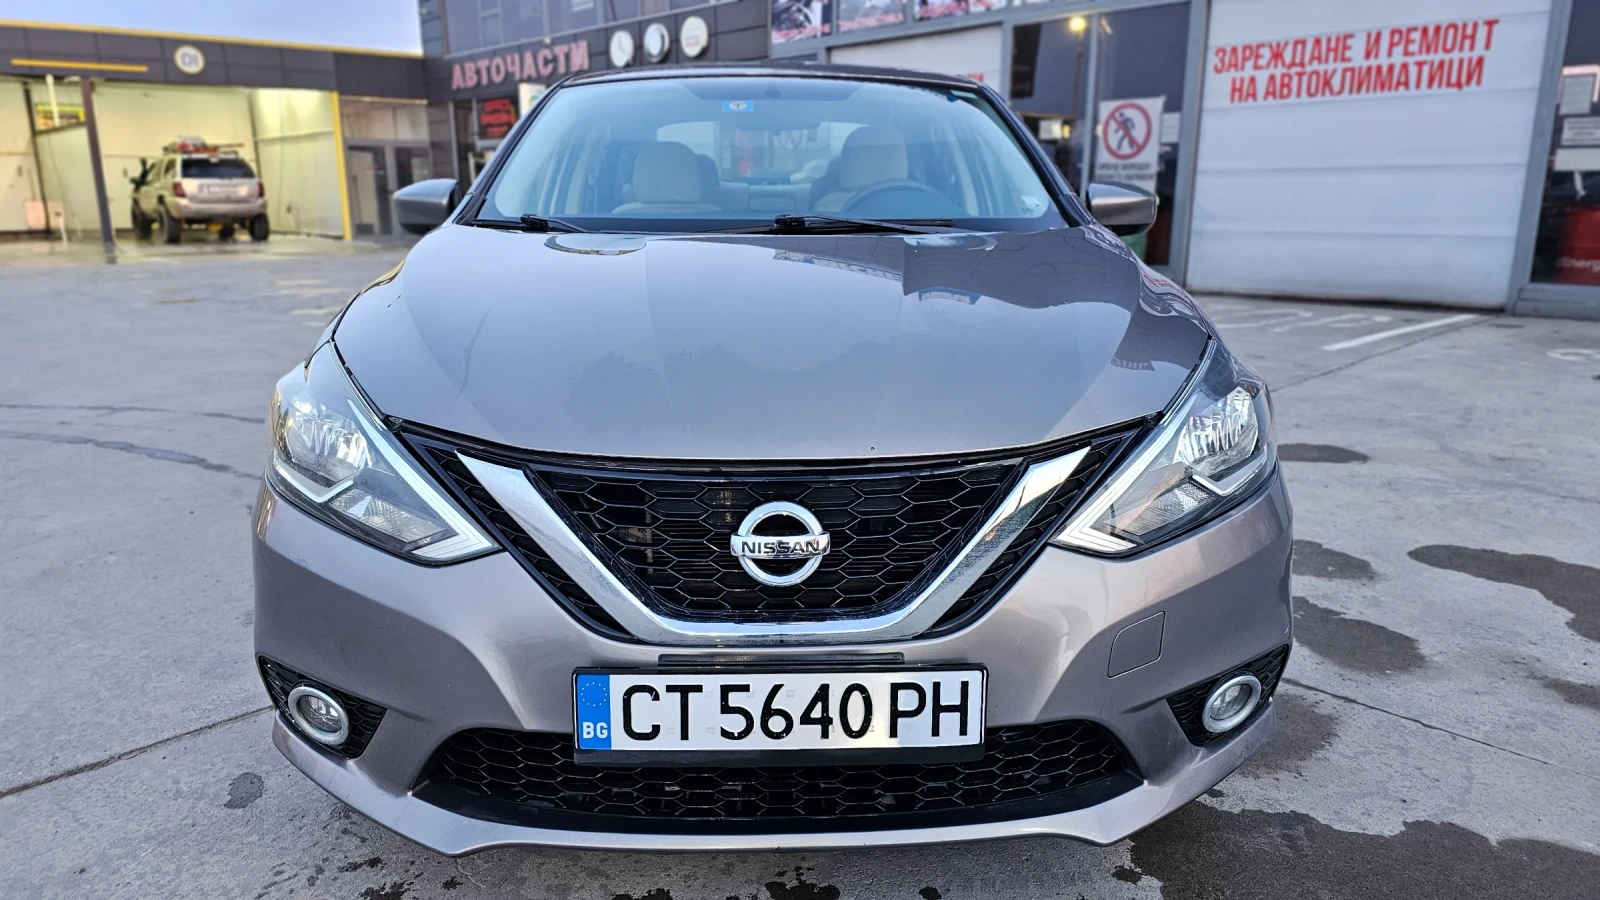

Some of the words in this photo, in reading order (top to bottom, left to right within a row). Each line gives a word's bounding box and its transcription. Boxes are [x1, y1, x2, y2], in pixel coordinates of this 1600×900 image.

[451, 40, 590, 90] АВТОЧАСТИ
[1213, 33, 1355, 74] ЗАРЕЖДАНЕ
[1363, 31, 1382, 61] И
[1387, 18, 1499, 58] РЕМОНТ
[1229, 75, 1258, 104] НА
[1263, 55, 1485, 101] АВТОКЛИМАТИЦИ
[741, 540, 820, 554] NISSAN
[582, 721, 608, 739] BG
[622, 684, 704, 741] CT
[719, 682, 874, 741] 5640
[888, 680, 970, 739] PH
